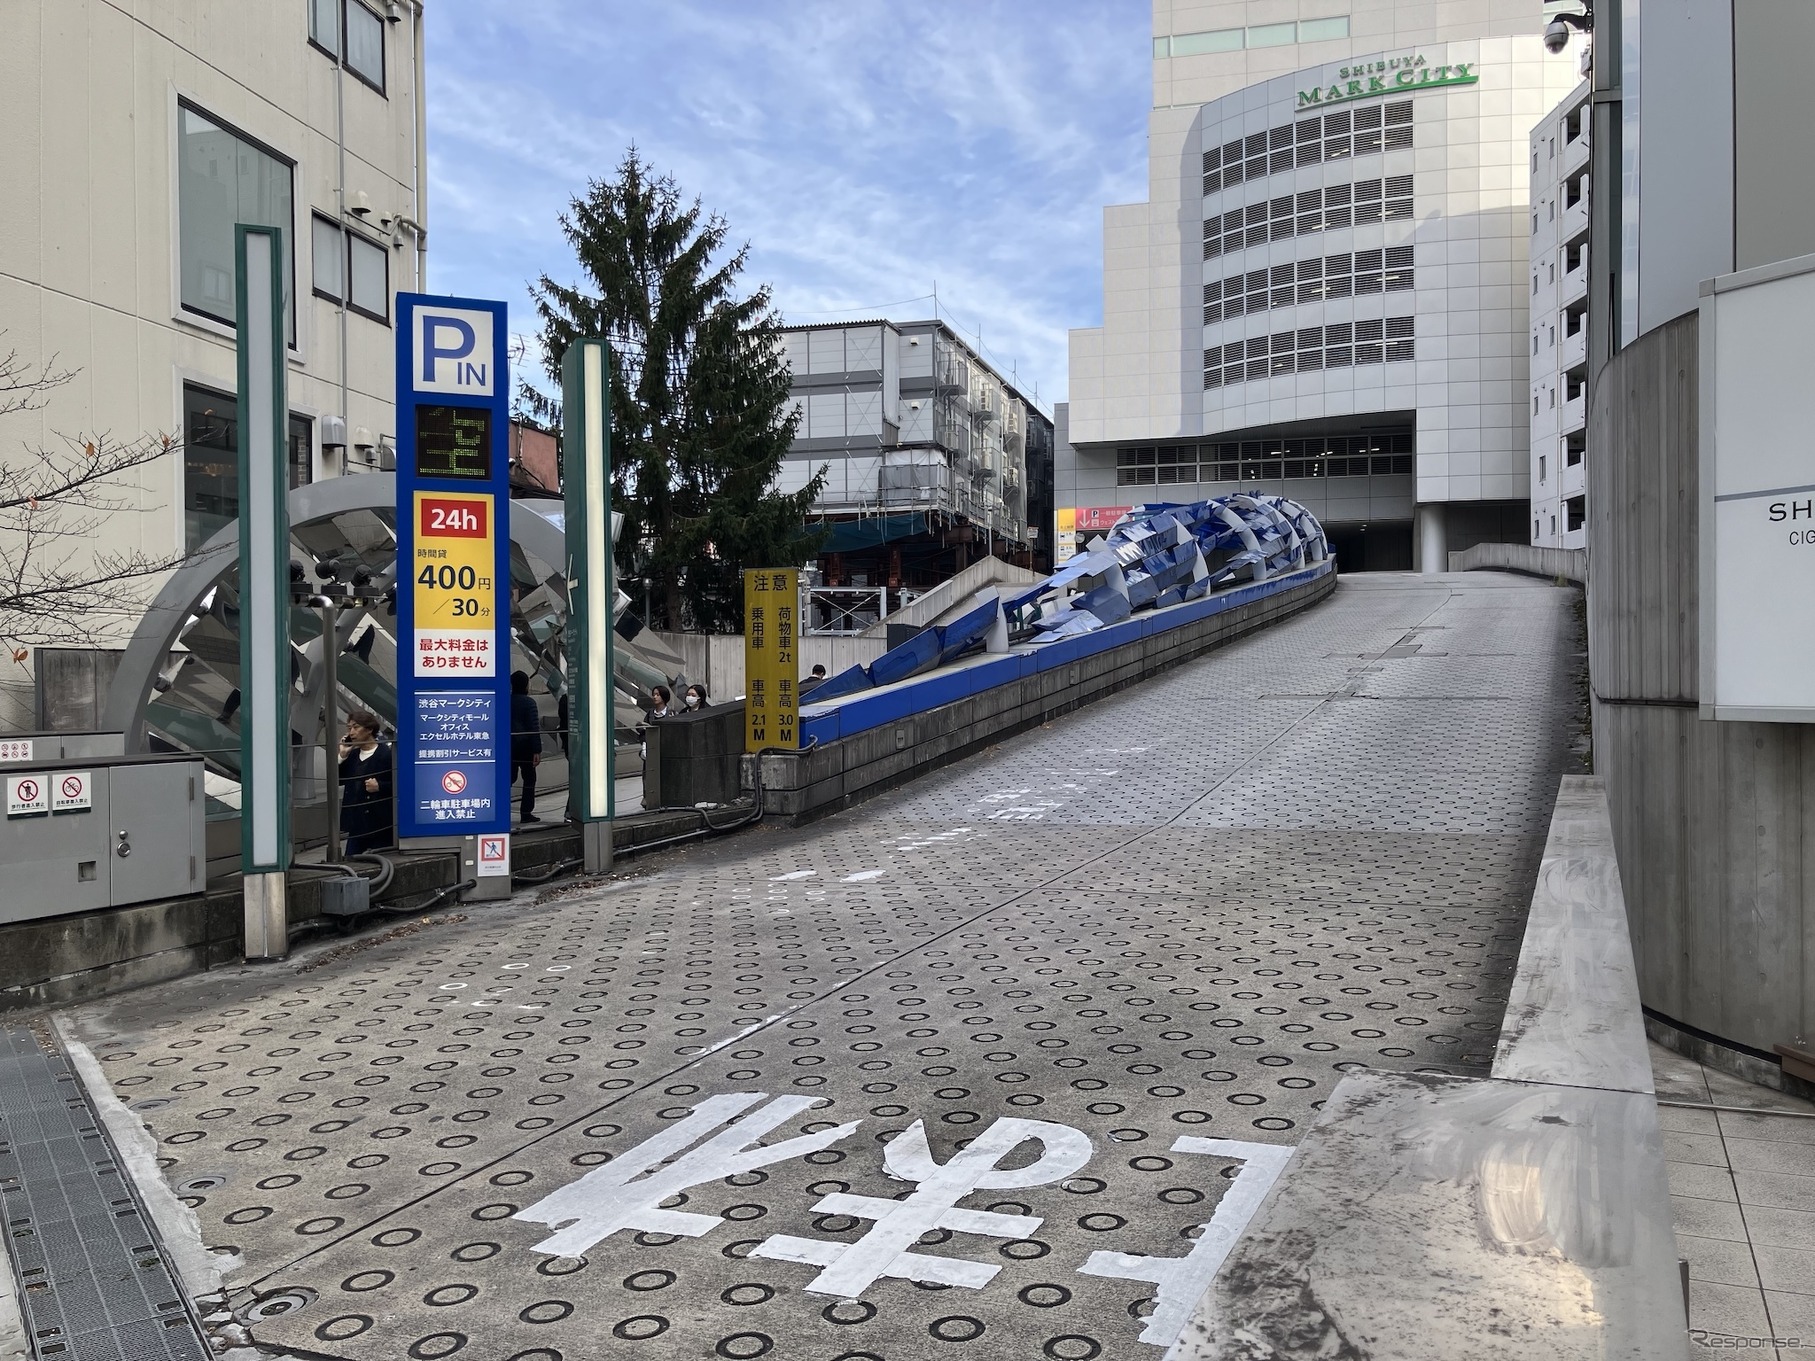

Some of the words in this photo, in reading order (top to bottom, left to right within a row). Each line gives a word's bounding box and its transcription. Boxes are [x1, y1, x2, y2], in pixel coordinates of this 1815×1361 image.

[1339, 54, 1427, 79] SHIBUYA
[1297, 75, 1386, 107] MARK
[1396, 62, 1475, 86] CITY
[423, 315, 476, 383] P
[457, 361, 487, 387] IN
[431, 508, 478, 531] 24h
[417, 549, 447, 559] 時間貸
[417, 565, 491, 590] 400円
[754, 574, 788, 592] 注意
[751, 606, 765, 650] 乗用車
[419, 639, 489, 652] 最大料金は
[422, 656, 487, 668] ありません
[752, 679, 765, 708] 車高
[779, 679, 792, 708] 車高
[418, 698, 492, 709] 渋谷マークシティ
[420, 713, 490, 722] マークシティモール
[752, 714, 766, 726] 2.1
[778, 714, 794, 726] 3.0
[440, 723, 470, 731] オフィス
[420, 732, 490, 741] エクセルホテル東急
[753, 728, 765, 741] M
[780, 729, 792, 742] M
[418, 748, 493, 759] 提携割引サービス有
[420, 798, 491, 810] 二輪車駐車場内
[435, 809, 476, 820] 進入禁止
